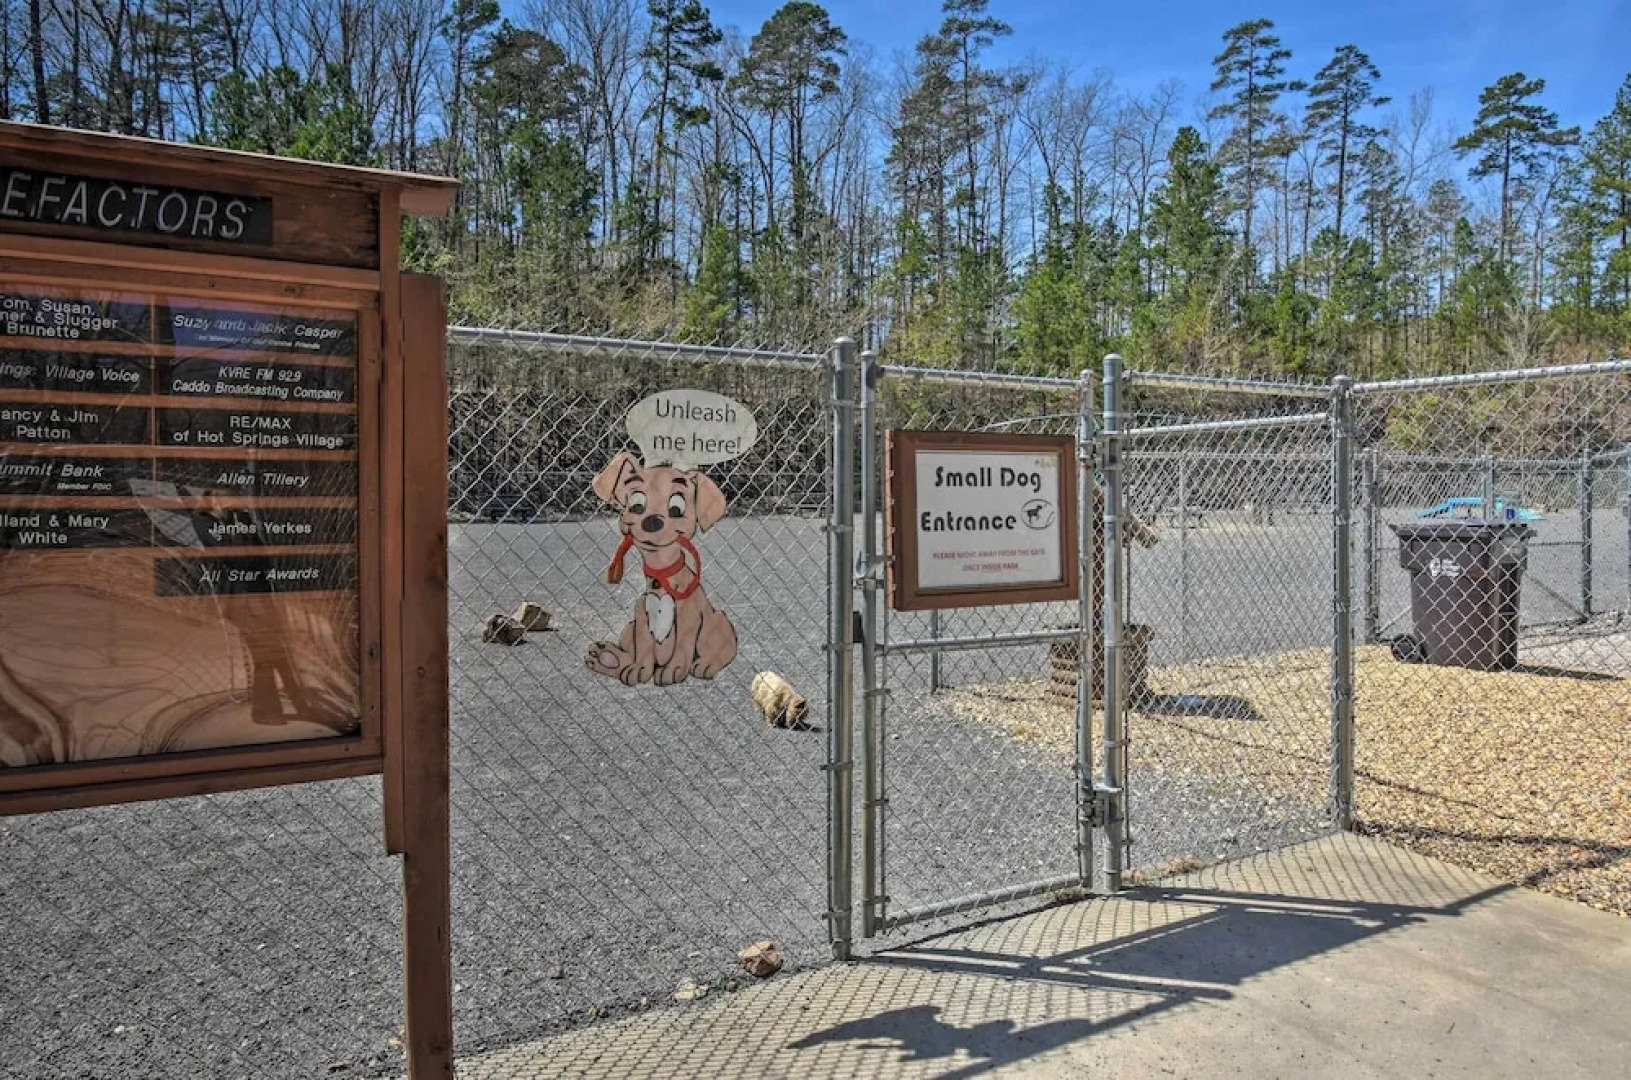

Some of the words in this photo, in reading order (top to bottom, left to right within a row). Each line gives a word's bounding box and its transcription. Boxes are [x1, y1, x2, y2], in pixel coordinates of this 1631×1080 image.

[0, 171, 247, 239] EFACTORS
[36, 311, 45, 323] &
[54, 312, 119, 331] Slugger
[174, 315, 212, 331] Suzy
[294, 325, 344, 341] Casper
[7, 321, 80, 338] Brunette
[46, 365, 95, 382] Village
[102, 368, 140, 382] Voice
[219, 366, 251, 379] KVRE
[255, 369, 273, 381] FM
[172, 380, 211, 393] Caddo
[215, 382, 289, 399] Broadcasting
[294, 386, 344, 402] Company
[1, 409, 42, 423] ancy
[50, 409, 60, 422] &
[68, 410, 99, 423] Jim
[656, 398, 737, 423] Unleash
[229, 416, 292, 430] RE/MAX
[17, 425, 71, 439] Patton
[173, 431, 190, 442] of
[198, 431, 224, 443] Hot
[232, 431, 289, 447] Springs
[296, 434, 344, 449] Village
[653, 434, 686, 451] me
[692, 432, 742, 454] here!
[61, 464, 104, 477] Bank
[57, 482, 89, 490] Member
[217, 472, 255, 486] Allen
[263, 473, 309, 487] Tillery
[934, 465, 993, 488] Small
[1000, 466, 1042, 494] Dog
[49, 514, 60, 528] &
[68, 514, 110, 529] Mary
[208, 522, 257, 536] James
[264, 522, 312, 535] Yerkes
[920, 511, 1018, 533] Entrance
[19, 531, 68, 544] White
[932, 551, 956, 560] PLEASE
[1002, 561, 1019, 570] PARK
[200, 570, 221, 582] All
[228, 570, 262, 582] Star
[265, 567, 319, 580] Awards
